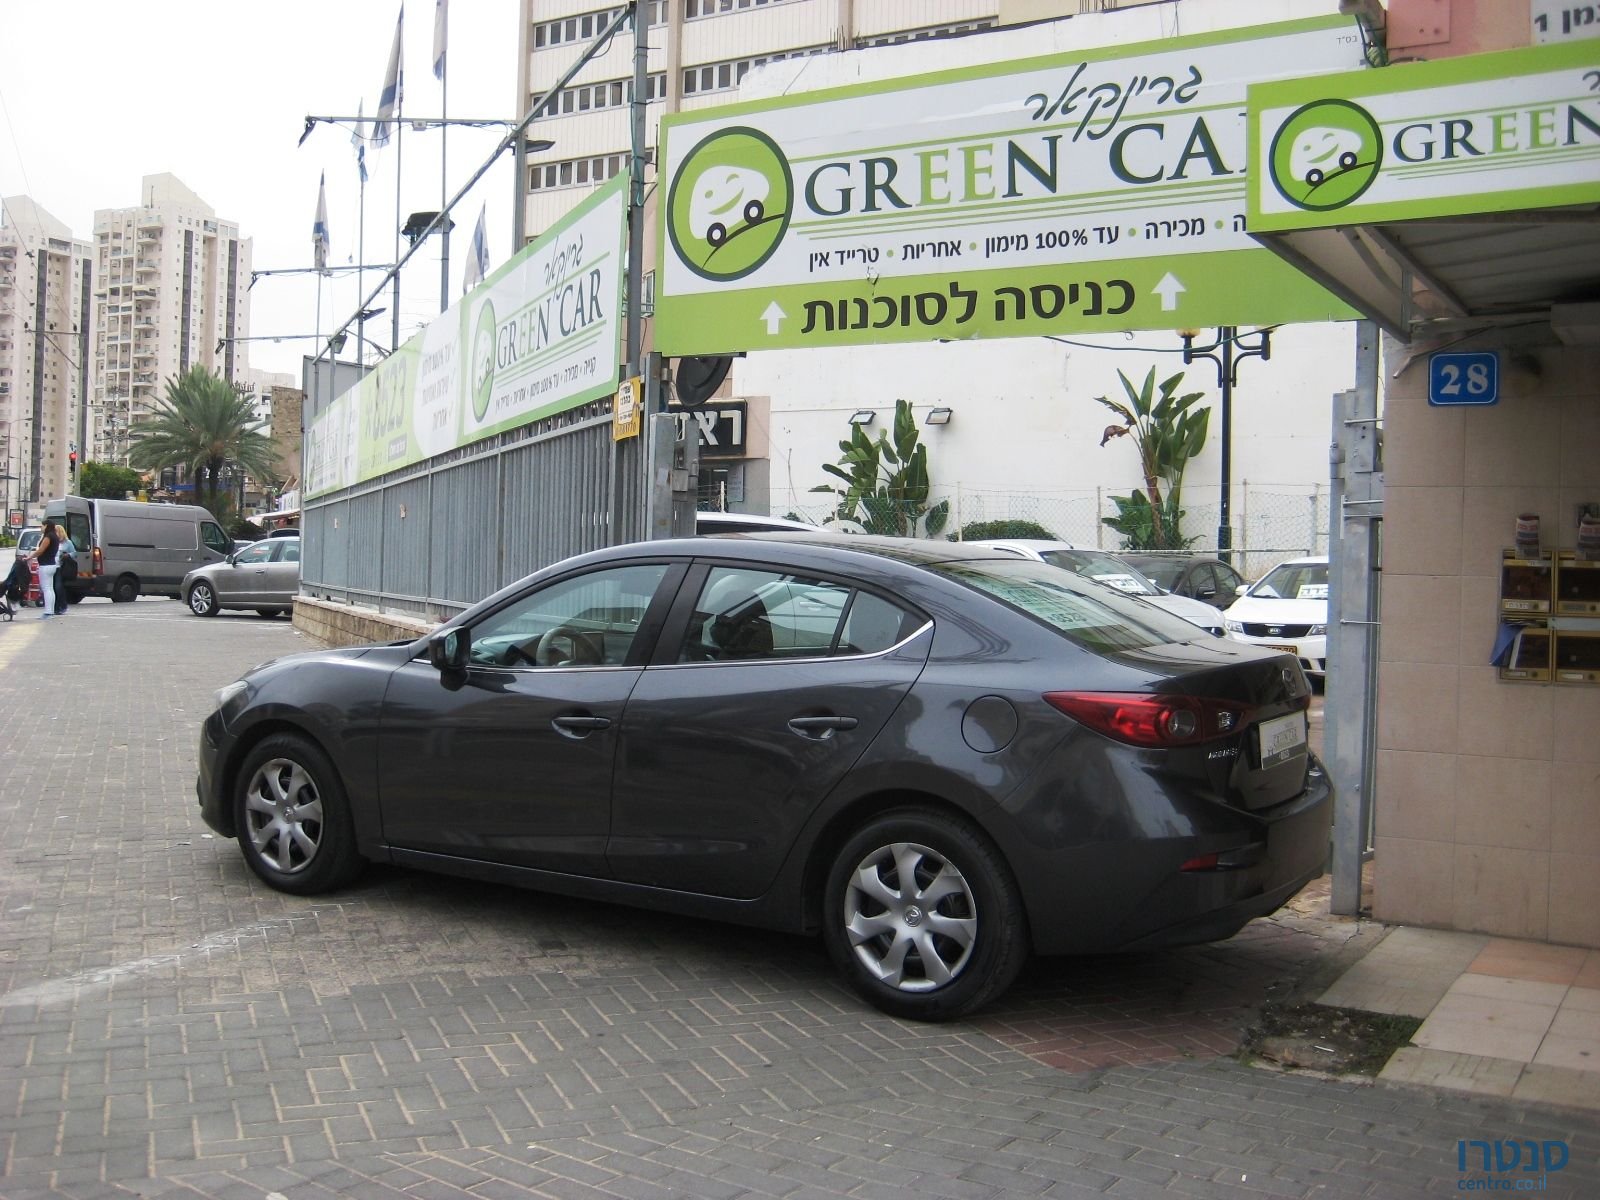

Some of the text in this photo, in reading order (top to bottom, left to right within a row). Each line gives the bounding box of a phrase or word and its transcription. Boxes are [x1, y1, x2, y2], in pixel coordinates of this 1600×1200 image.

[1024, 62, 1203, 142] גרינקאר
[1393, 105, 1600, 163] GREEN
[804, 134, 1063, 217] GREEN
[809, 217, 1205, 272] מכירה עד 100% מימון אחריות טרייד אין
[497, 268, 603, 370] GREEN CAR
[801, 279, 1135, 334] כניסה לסוכנות
[1440, 363, 1488, 395] 28
